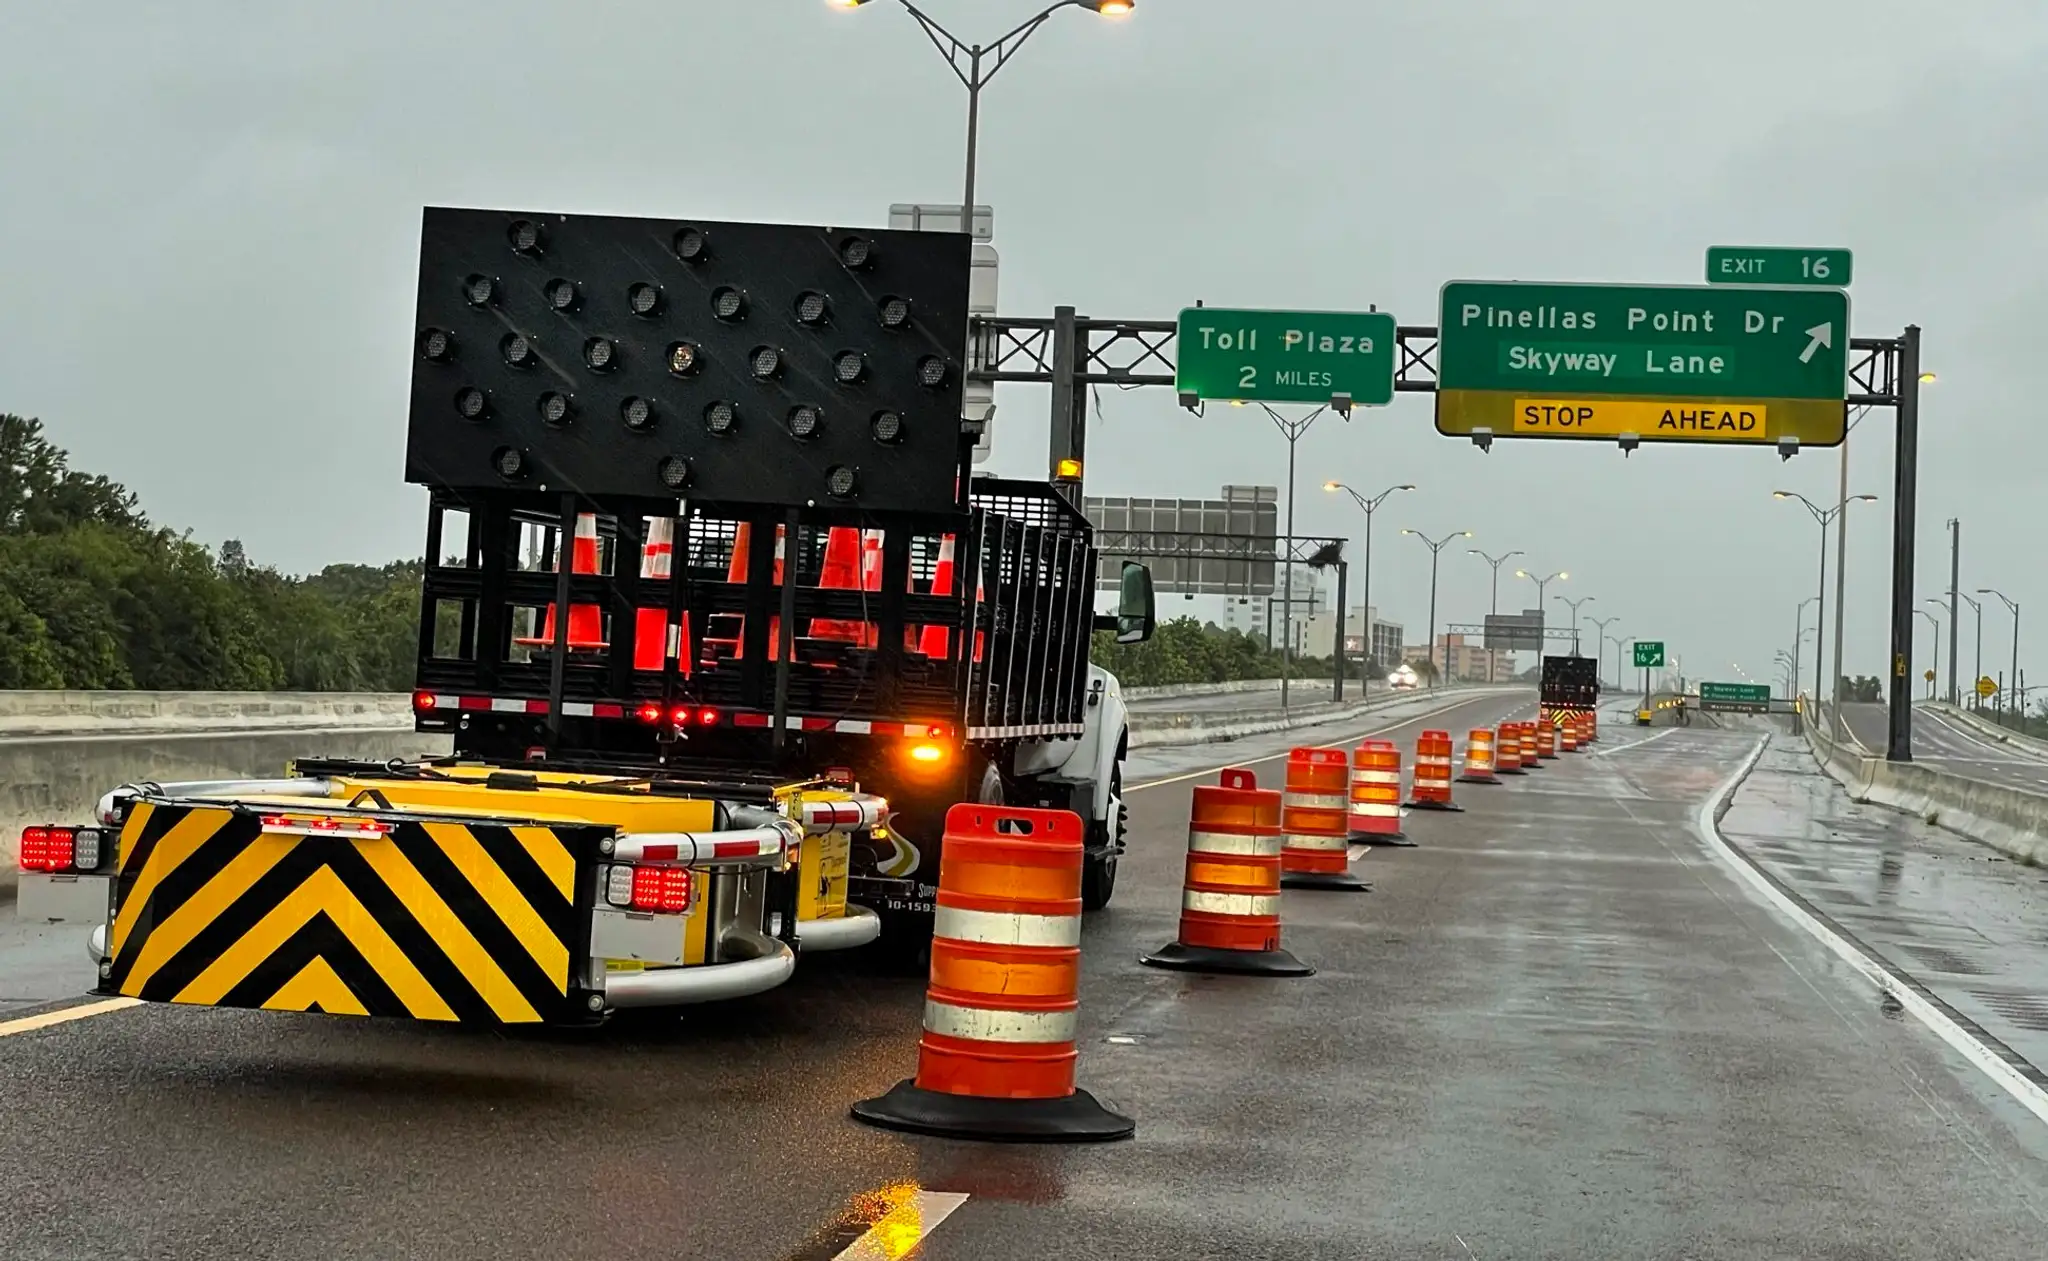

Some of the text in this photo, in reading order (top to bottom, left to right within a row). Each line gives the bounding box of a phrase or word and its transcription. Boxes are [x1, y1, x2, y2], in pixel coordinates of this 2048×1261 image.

[1720, 256, 1830, 279] EXIT 16
[1461, 304, 1785, 335] Pinellas Point Dr
[1199, 327, 1373, 353] Toll Plaza
[1508, 345, 1725, 376] Skyway Lane
[1238, 366, 1332, 388] 2 MILES
[1524, 406, 1757, 432] STOP AHEAD
[1636, 653, 1646, 662] 16
